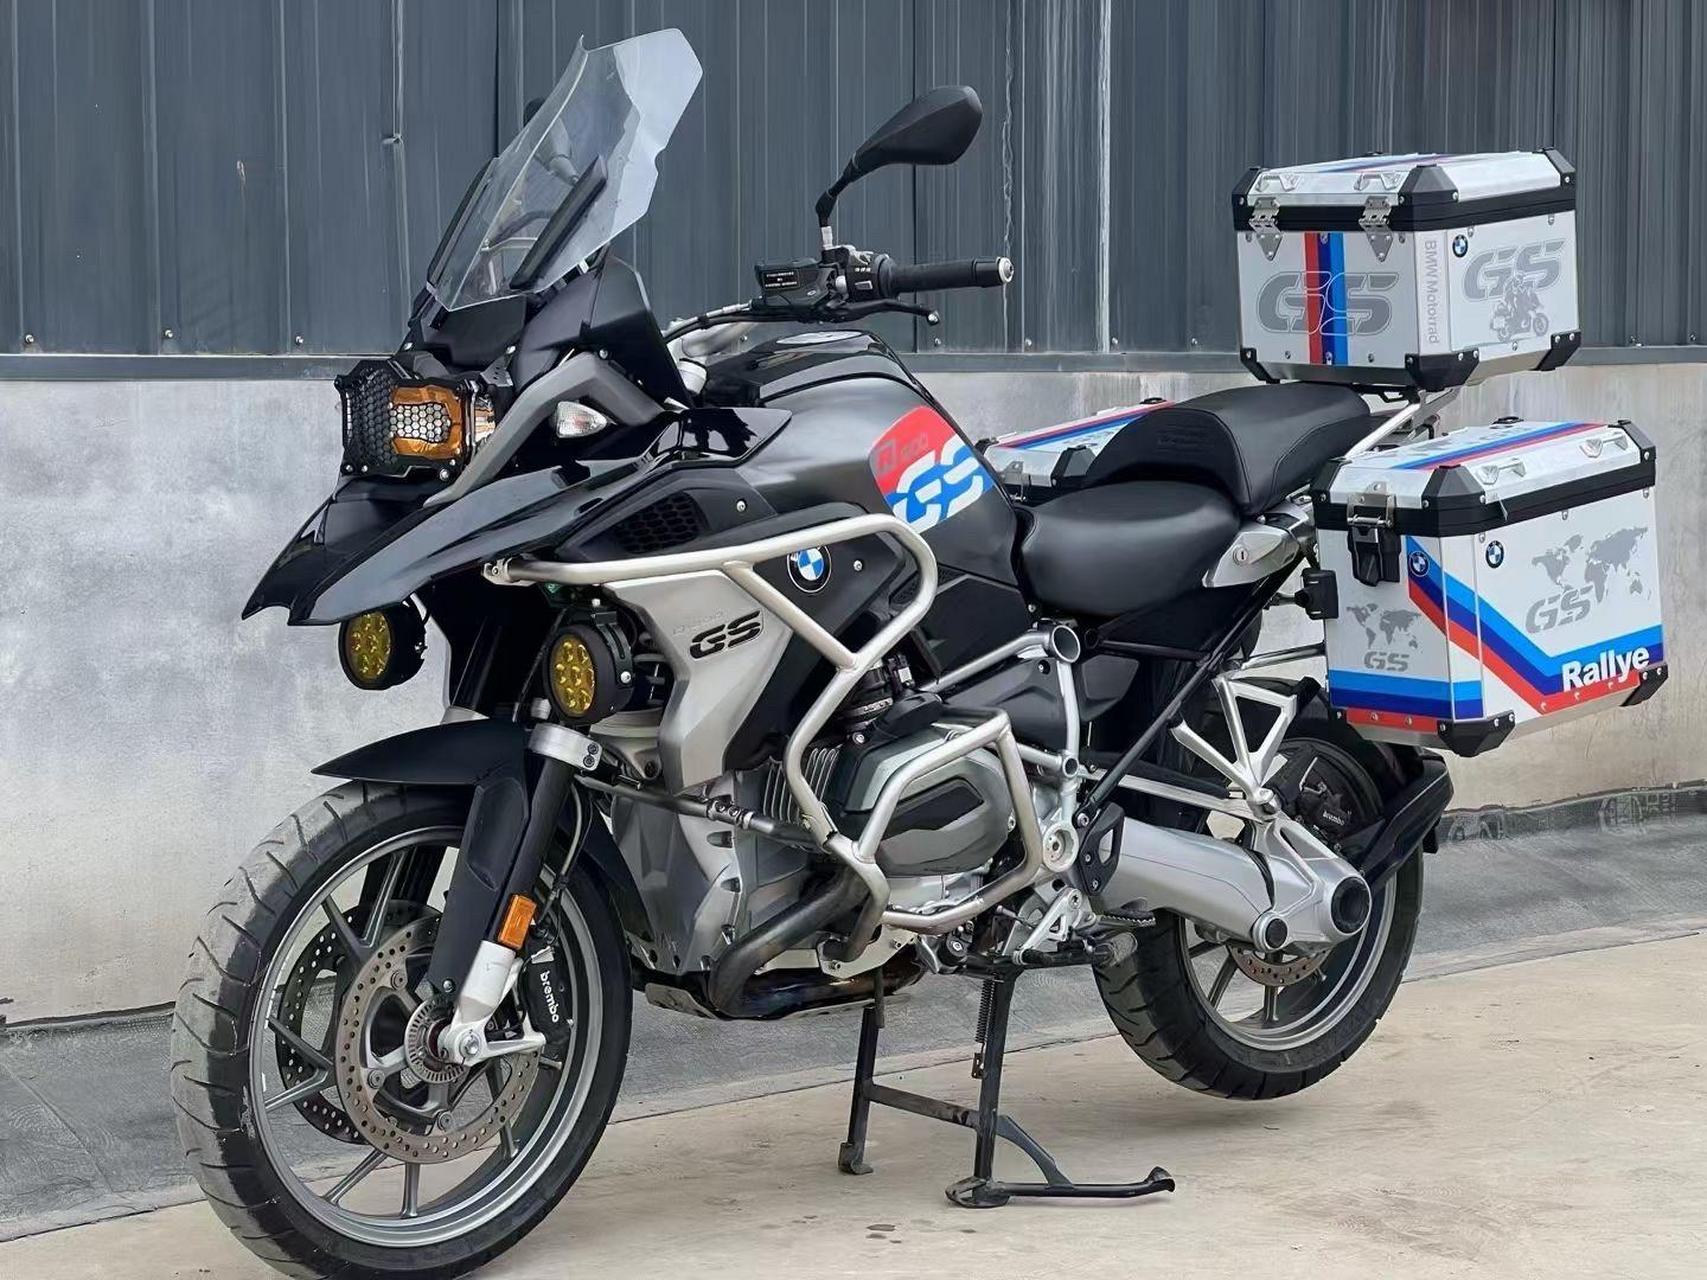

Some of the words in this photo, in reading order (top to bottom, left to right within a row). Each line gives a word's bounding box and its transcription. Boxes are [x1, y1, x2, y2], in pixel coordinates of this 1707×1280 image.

[1424, 240, 1438, 278] BMW
[1464, 238, 1570, 301] GS
[1256, 271, 1400, 336] GS
[1427, 280, 1440, 344] Motorrad
[892, 434, 984, 534] GS
[1525, 584, 1595, 633] GS
[690, 610, 761, 659] GS
[1364, 651, 1410, 672] GS
[1562, 646, 1649, 692] Rallye
[540, 970, 559, 1023] brembo
